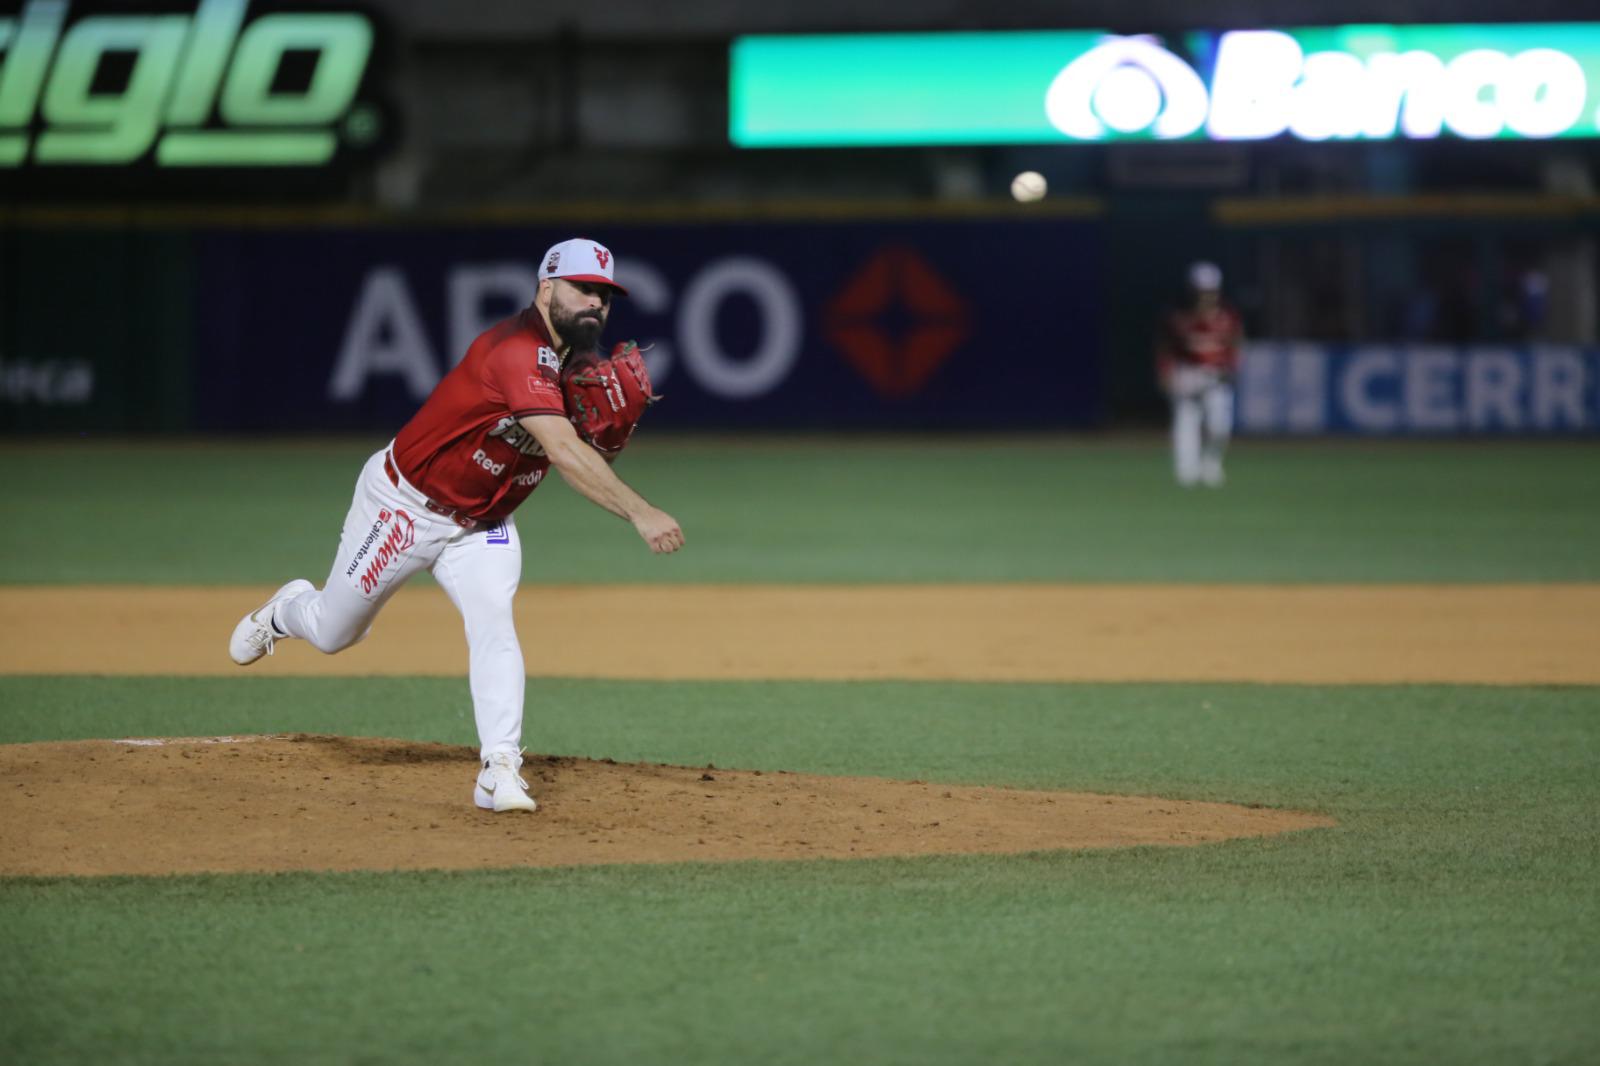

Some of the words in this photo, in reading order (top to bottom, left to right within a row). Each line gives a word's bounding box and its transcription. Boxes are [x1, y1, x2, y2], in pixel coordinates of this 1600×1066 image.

[1206, 29, 1588, 141] Banco
[1341, 346, 1586, 428] CERR
[472, 448, 506, 476] Red
[346, 520, 384, 578] caliente.mx
[361, 508, 416, 594] Caliente
